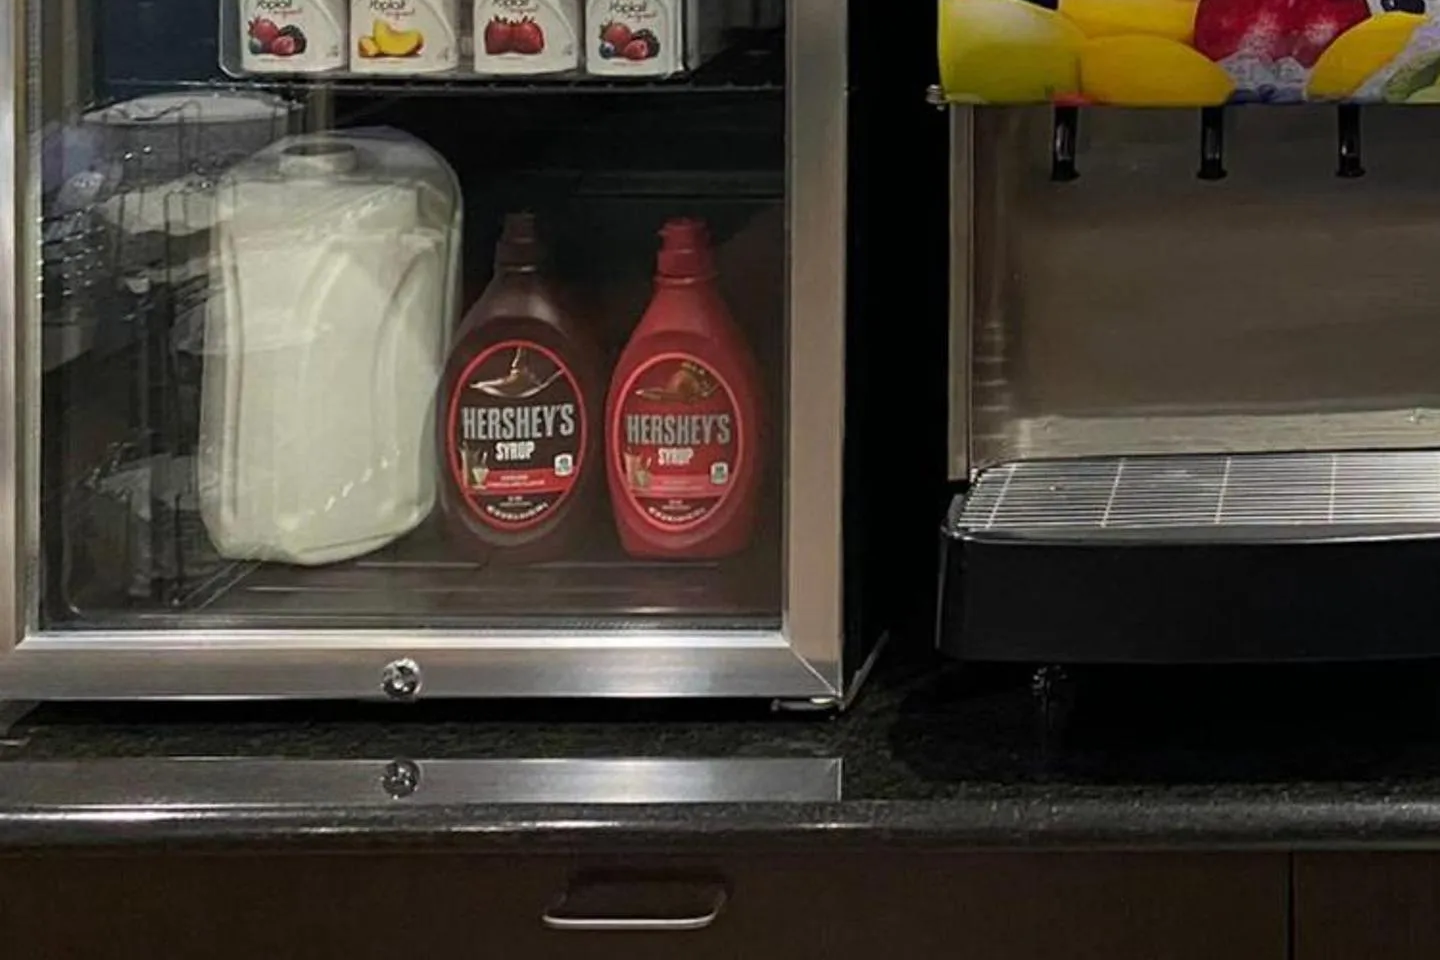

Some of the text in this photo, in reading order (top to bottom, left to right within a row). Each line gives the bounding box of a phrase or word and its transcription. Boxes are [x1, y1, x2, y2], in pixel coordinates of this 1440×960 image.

[461, 404, 575, 440] HERSHEY'S
[626, 414, 732, 447] HERSHEY'S
[495, 441, 535, 461] SYRUP
[657, 448, 694, 465] SYRUP
